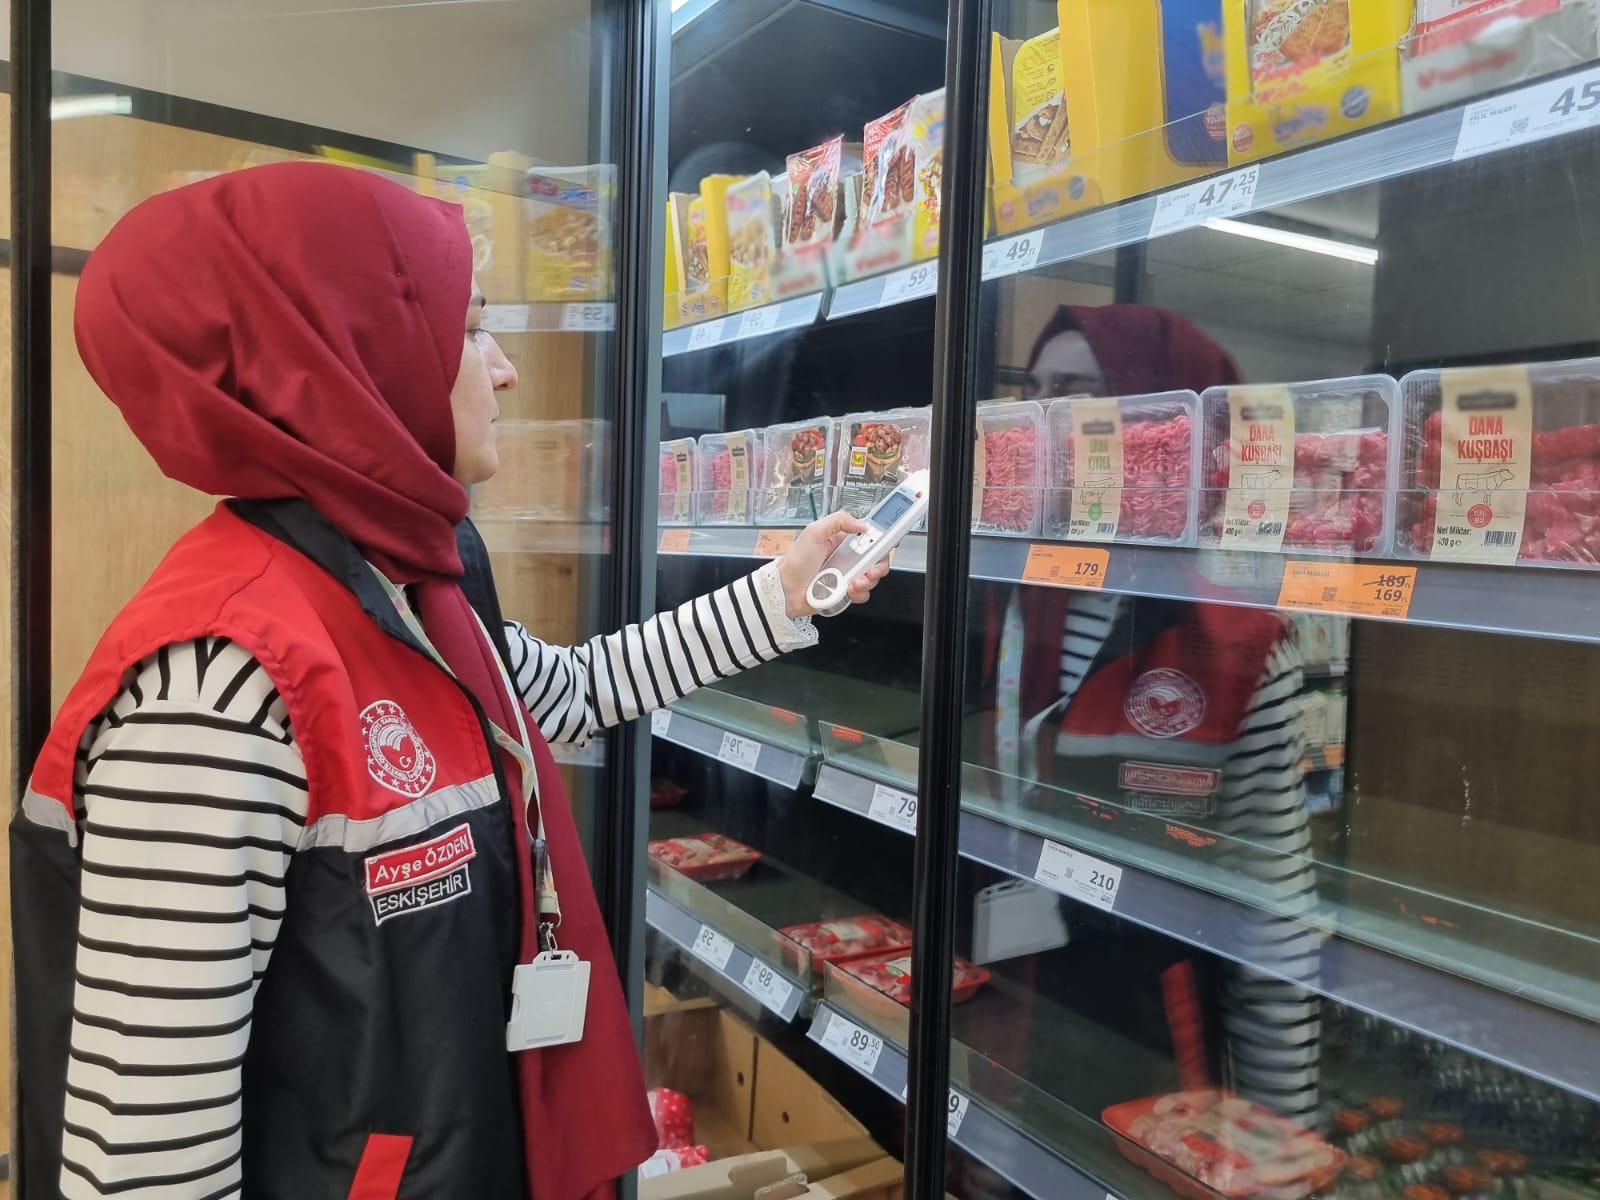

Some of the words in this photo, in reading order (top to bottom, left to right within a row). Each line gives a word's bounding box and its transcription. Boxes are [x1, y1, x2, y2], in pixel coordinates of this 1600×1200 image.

[1549, 80, 1600, 116] 45
[1007, 239, 1030, 260] 49
[908, 267, 927, 287] 59
[1249, 424, 1274, 442] DANA
[1469, 416, 1503, 435] DANA
[1240, 445, 1281, 464] KUŞBAŞI
[1457, 439, 1513, 462] KUŞBAŞI
[1437, 526, 1448, 535] Net
[1449, 526, 1472, 536] Miktar:
[1075, 562, 1099, 576] 179
[1377, 574, 1406, 588] 189
[1374, 589, 1402, 602] 169
[898, 797, 917, 818] 79
[374, 859, 422, 883] Ayşe
[425, 834, 469, 867] ÖZDEN
[1090, 870, 1115, 891] 210
[376, 874, 464, 914] ESKİŞEHİR
[850, 1030, 869, 1051] 89
